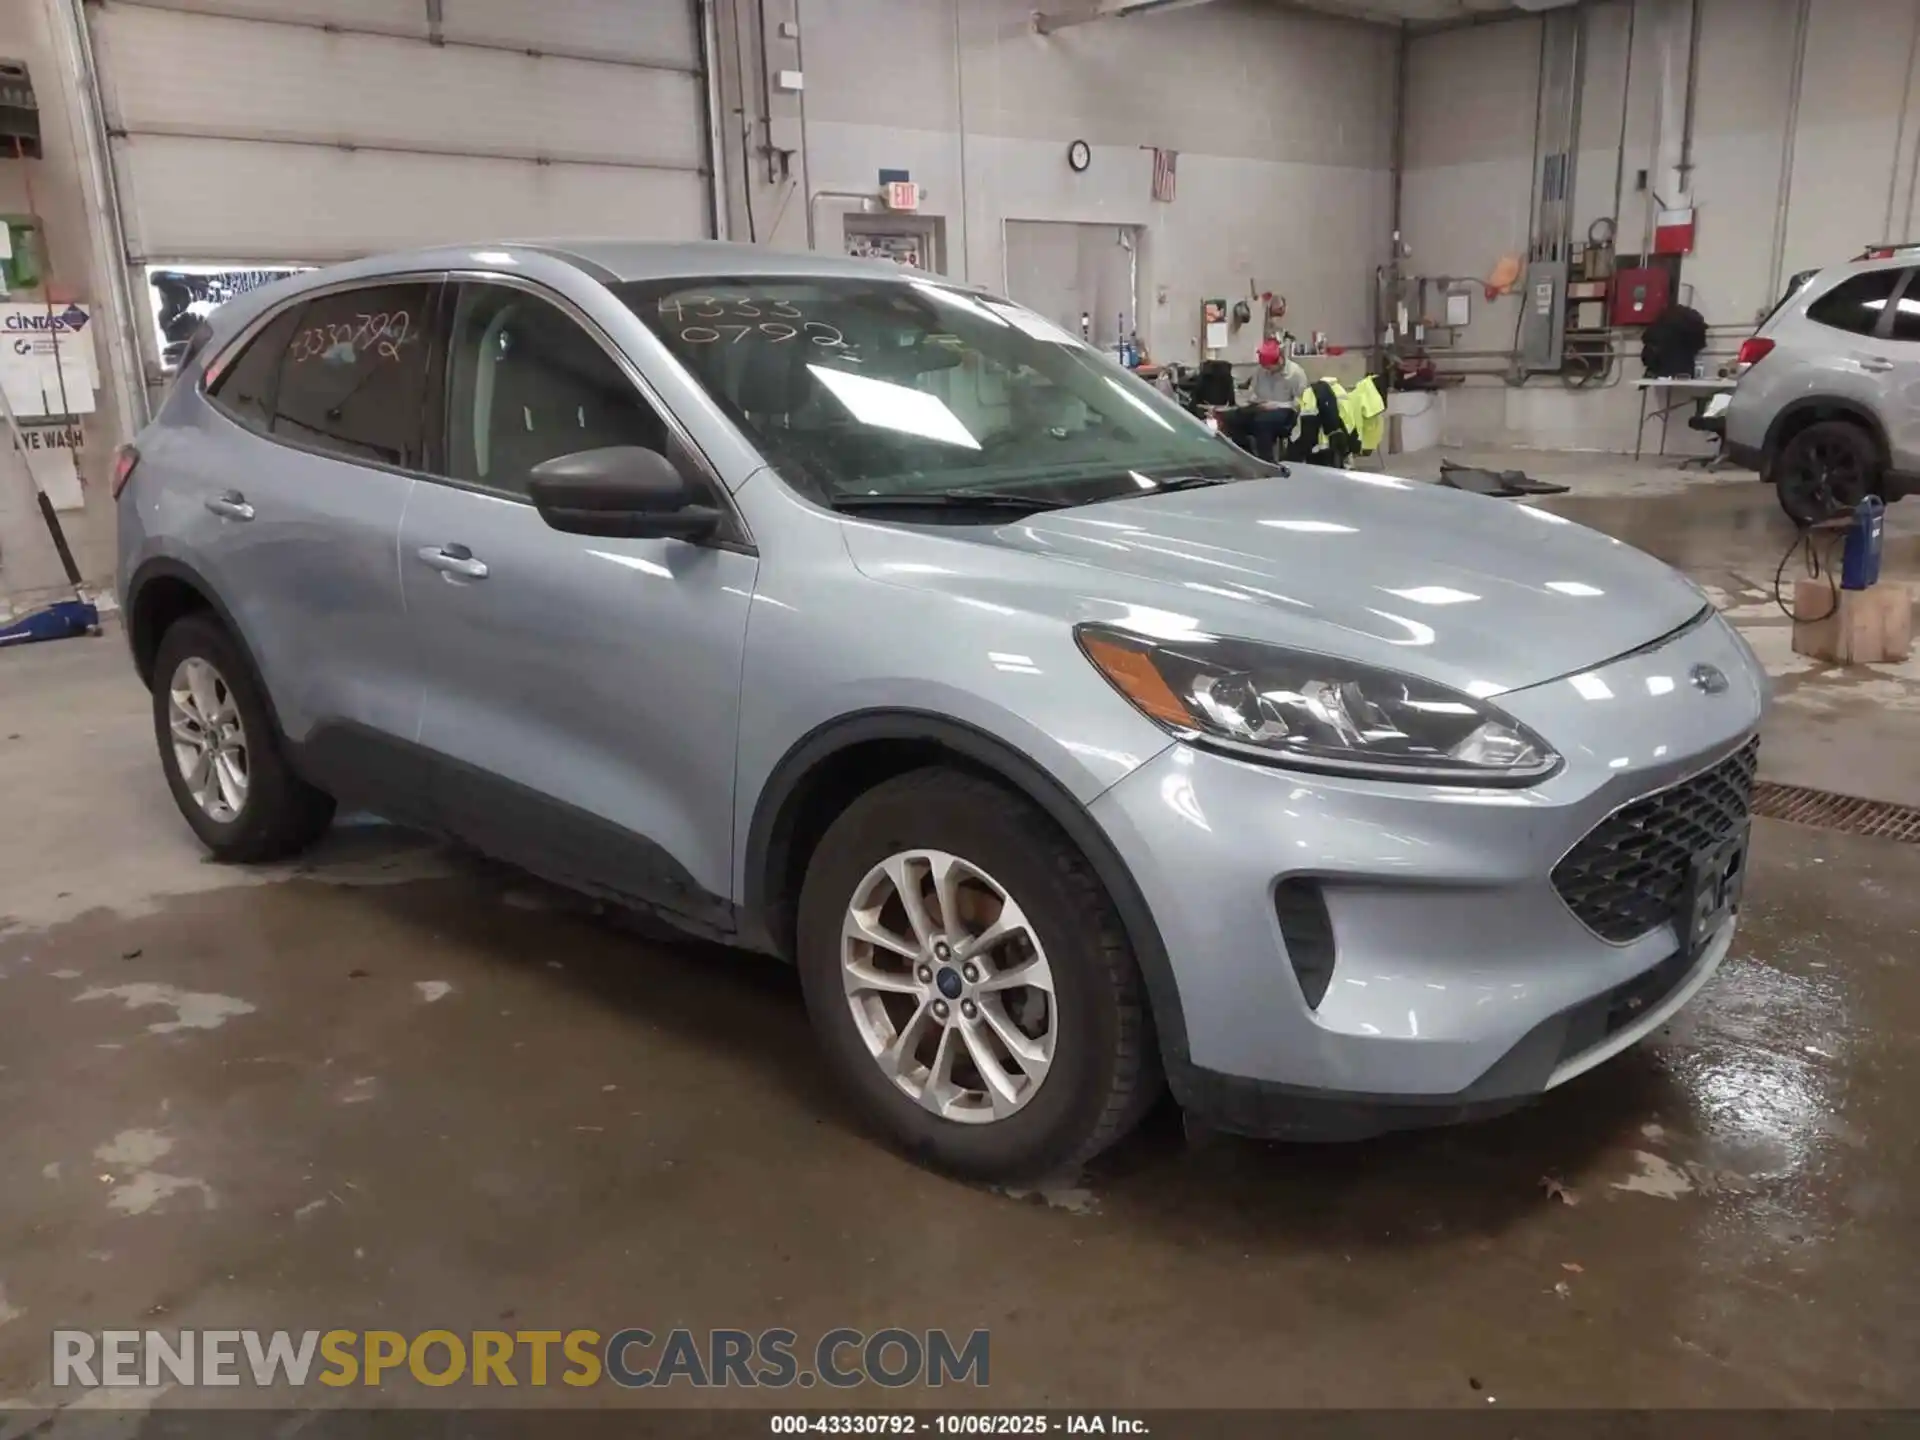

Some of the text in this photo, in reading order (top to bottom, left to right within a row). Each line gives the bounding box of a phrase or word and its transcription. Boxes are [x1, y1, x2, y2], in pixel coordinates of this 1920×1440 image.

[894, 184, 915, 206] EXIT
[658, 295, 802, 322] 4333
[681, 321, 848, 348] 0792
[42, 429, 84, 449] WASH
